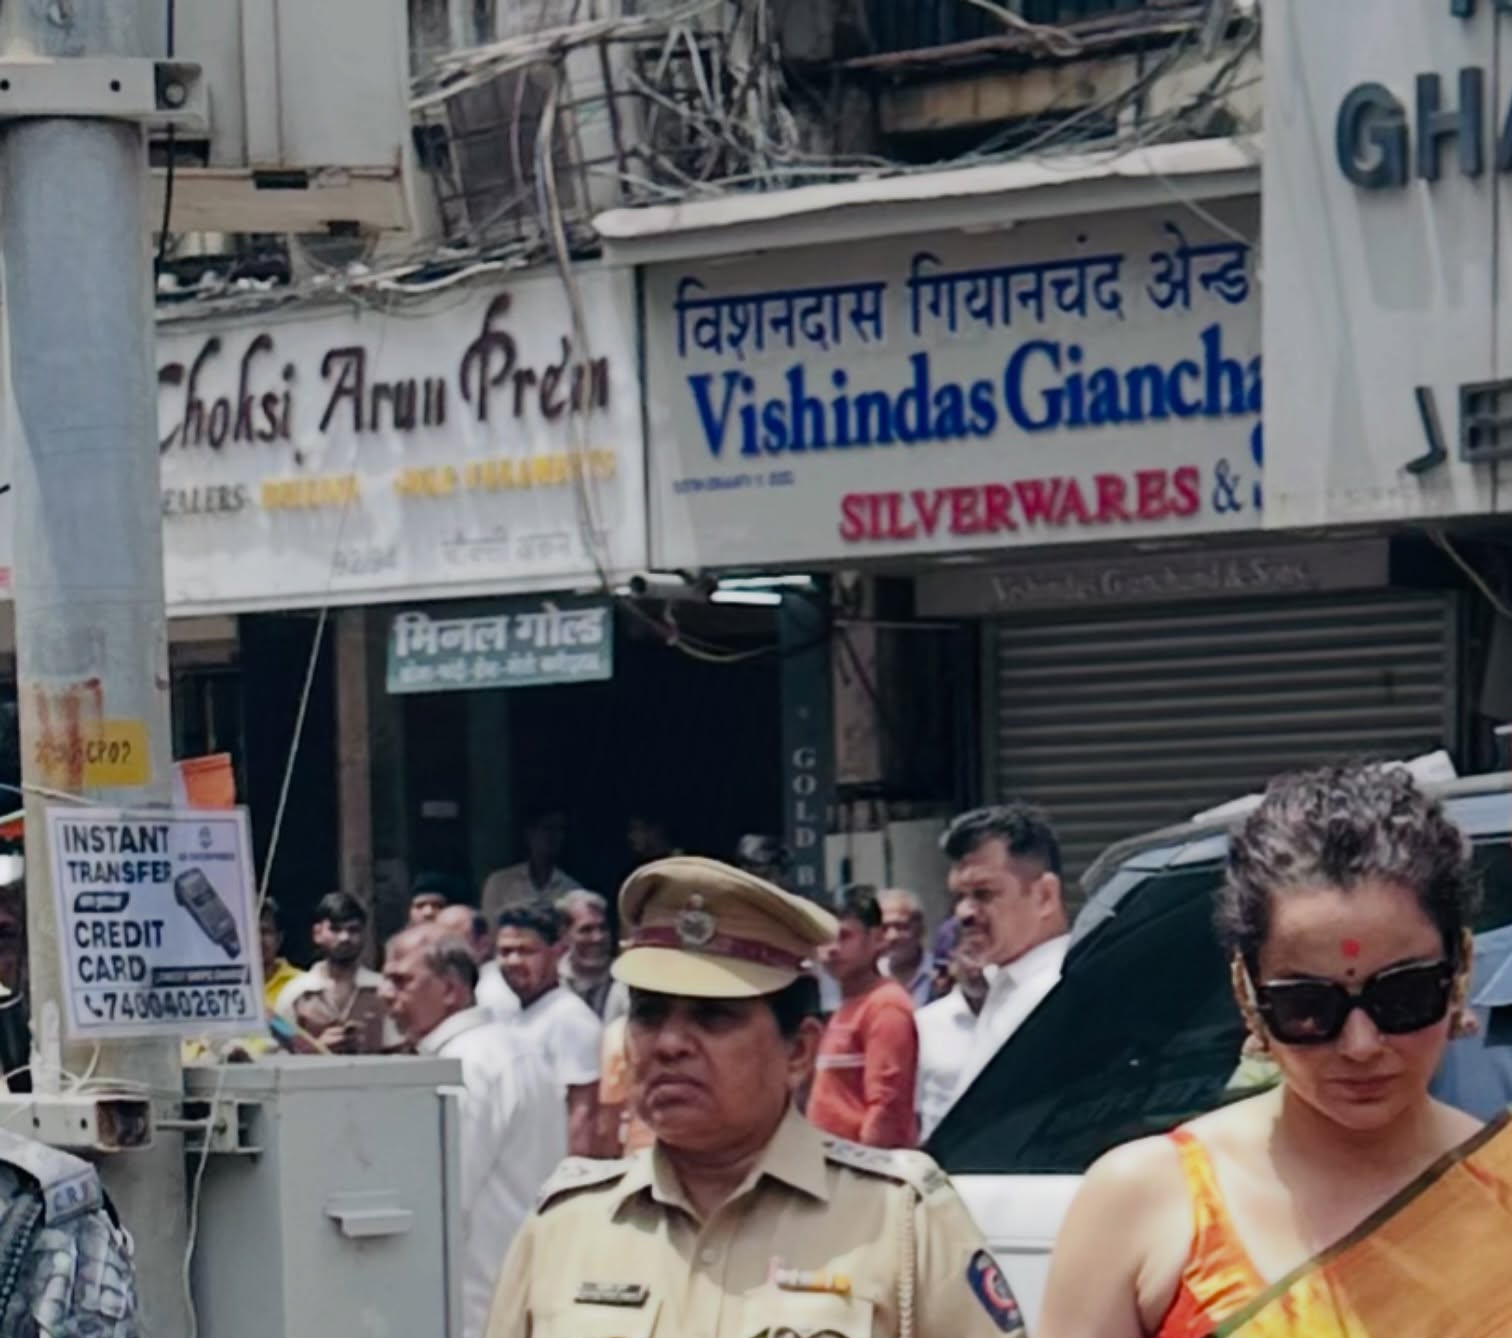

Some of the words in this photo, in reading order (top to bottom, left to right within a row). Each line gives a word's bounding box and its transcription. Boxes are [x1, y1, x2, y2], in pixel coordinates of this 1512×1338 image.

[673, 275, 888, 363] विशनदास
[905, 233, 1126, 337] गियानचंद
[686, 351, 998, 461] Vishindas
[839, 465, 1202, 543] SILVERWARES
[1212, 457, 1243, 515] &
[63, 824, 171, 855] INSTANT
[66, 859, 172, 885] TRANSFER
[74, 919, 165, 949] CREDIT
[77, 953, 147, 984] CARD
